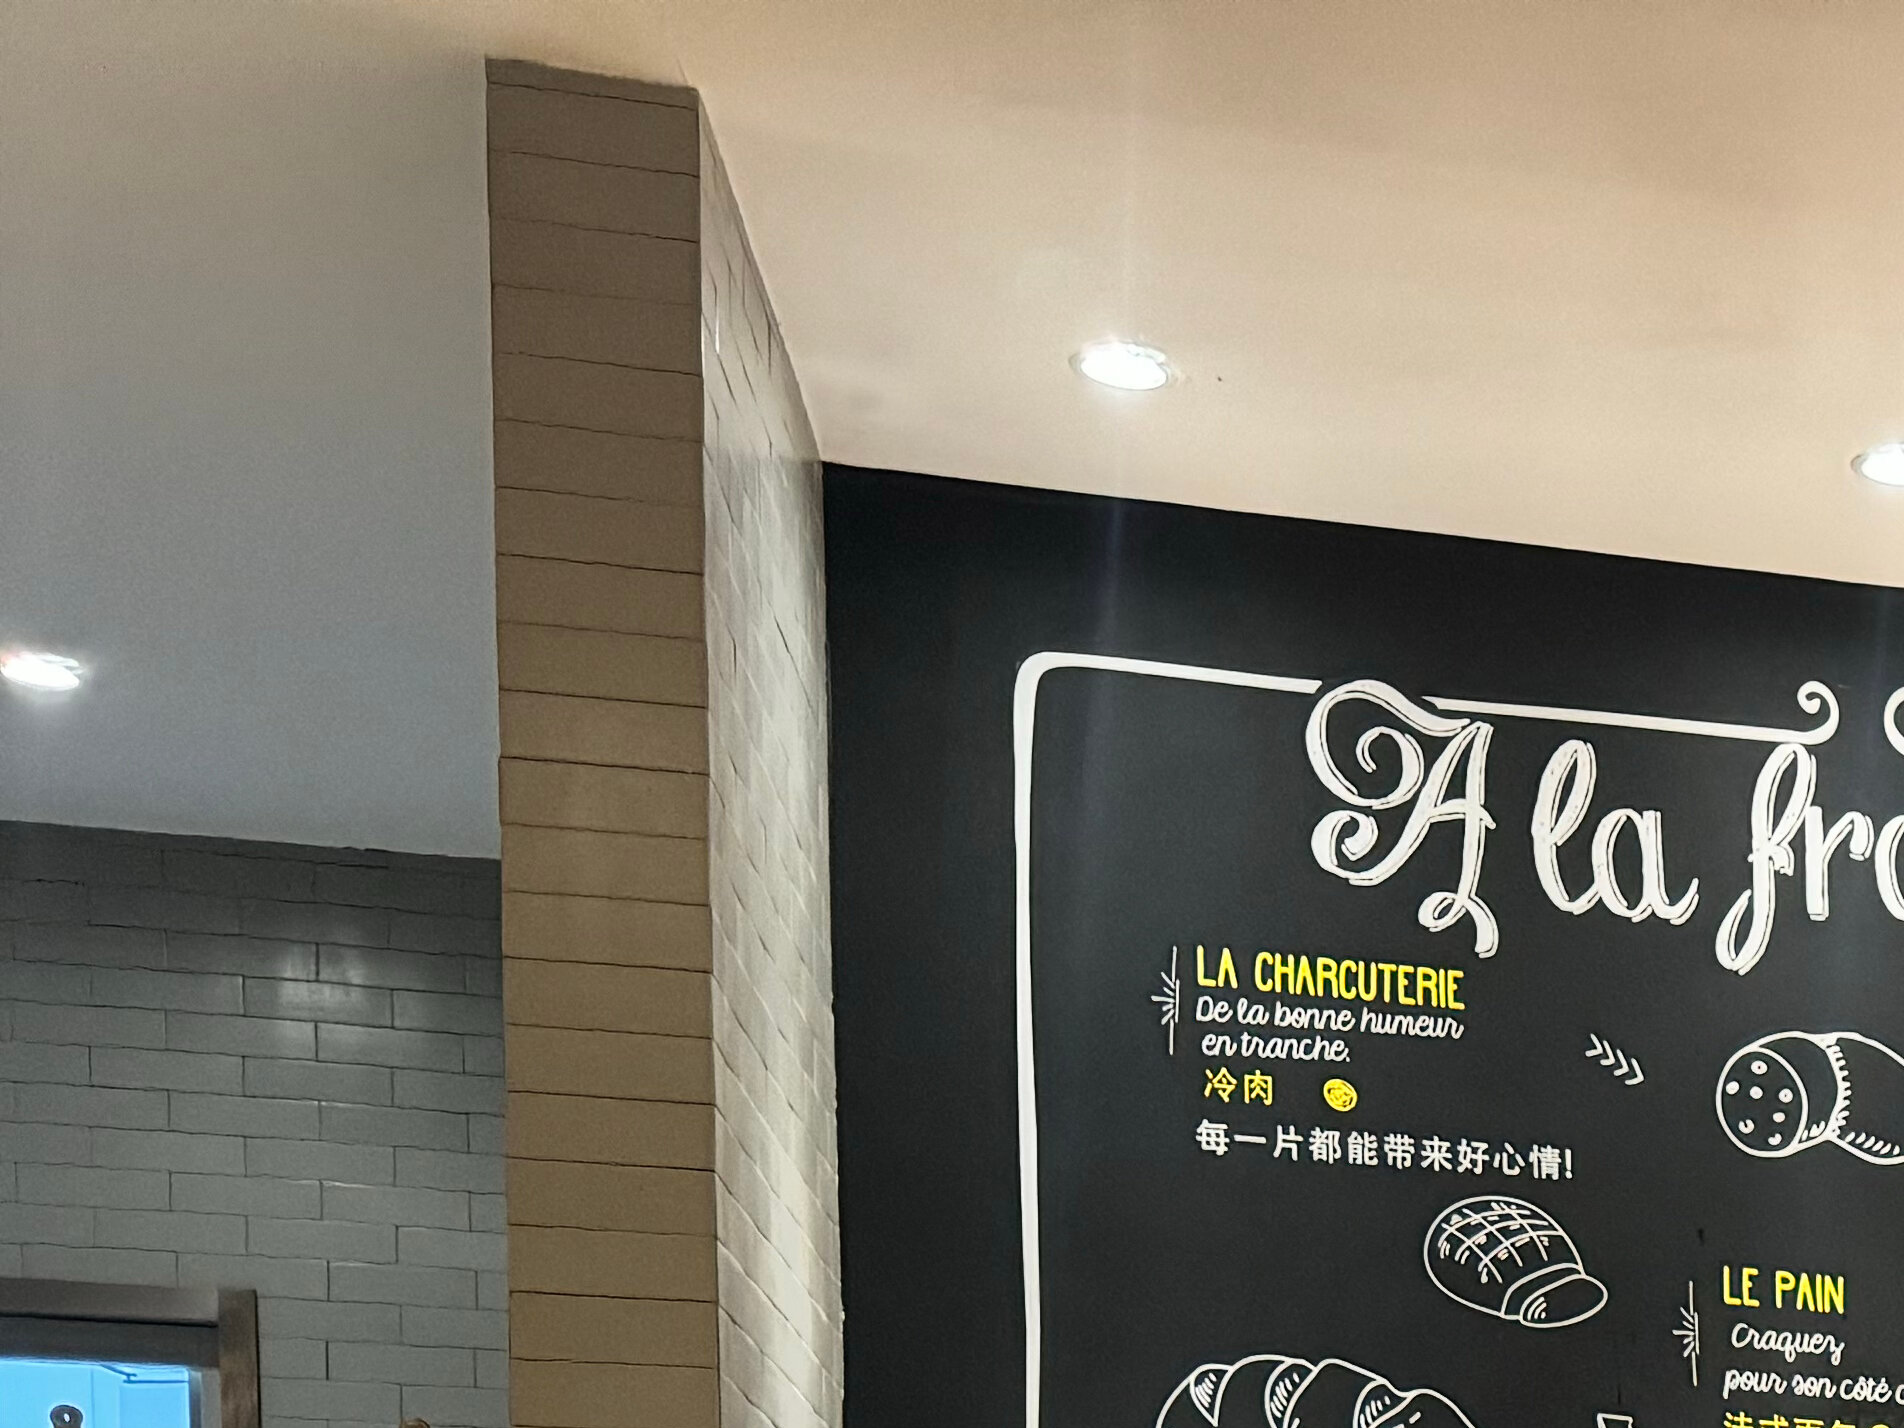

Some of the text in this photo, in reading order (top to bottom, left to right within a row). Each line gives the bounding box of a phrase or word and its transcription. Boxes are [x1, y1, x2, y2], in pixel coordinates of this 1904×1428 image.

[1531, 739, 1701, 925] la
[1196, 944, 1466, 1011] LA CHARCUTERIE
[1195, 995, 1465, 1040] De la bonne humeur
[1201, 1031, 1351, 1062] en tranche.
[1203, 1066, 1273, 1106] 冷肉
[1722, 1264, 1846, 1315] LE PAIN
[1731, 1321, 1846, 1366] Craquez
[1722, 1368, 1788, 1400] pour
[1791, 1375, 1837, 1399] son
[1839, 1375, 1894, 1404] côté
